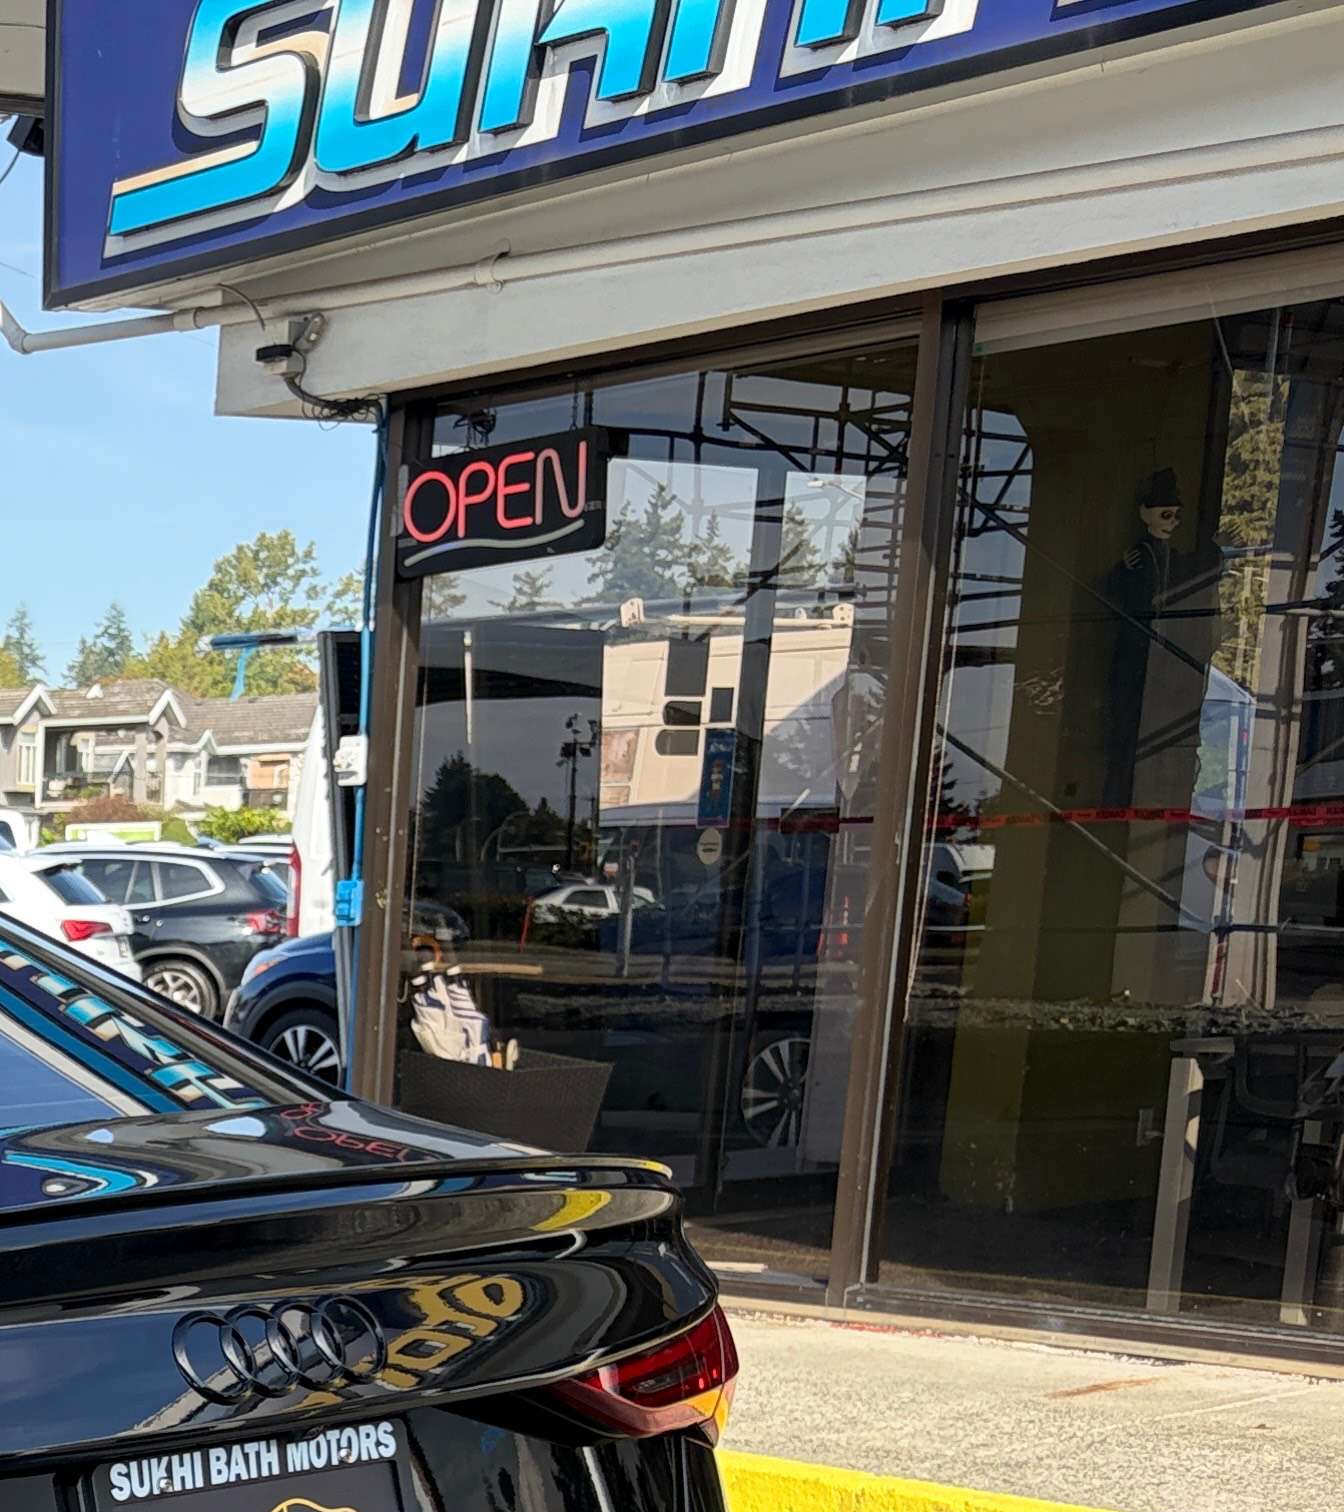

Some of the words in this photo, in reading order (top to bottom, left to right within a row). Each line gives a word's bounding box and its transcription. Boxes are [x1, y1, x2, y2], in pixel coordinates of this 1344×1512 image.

[403, 440, 587, 543] OPEN
[111, 1451, 204, 1502] SUKHI
[209, 1440, 280, 1486] BATH
[286, 1421, 397, 1474] MOTORS
